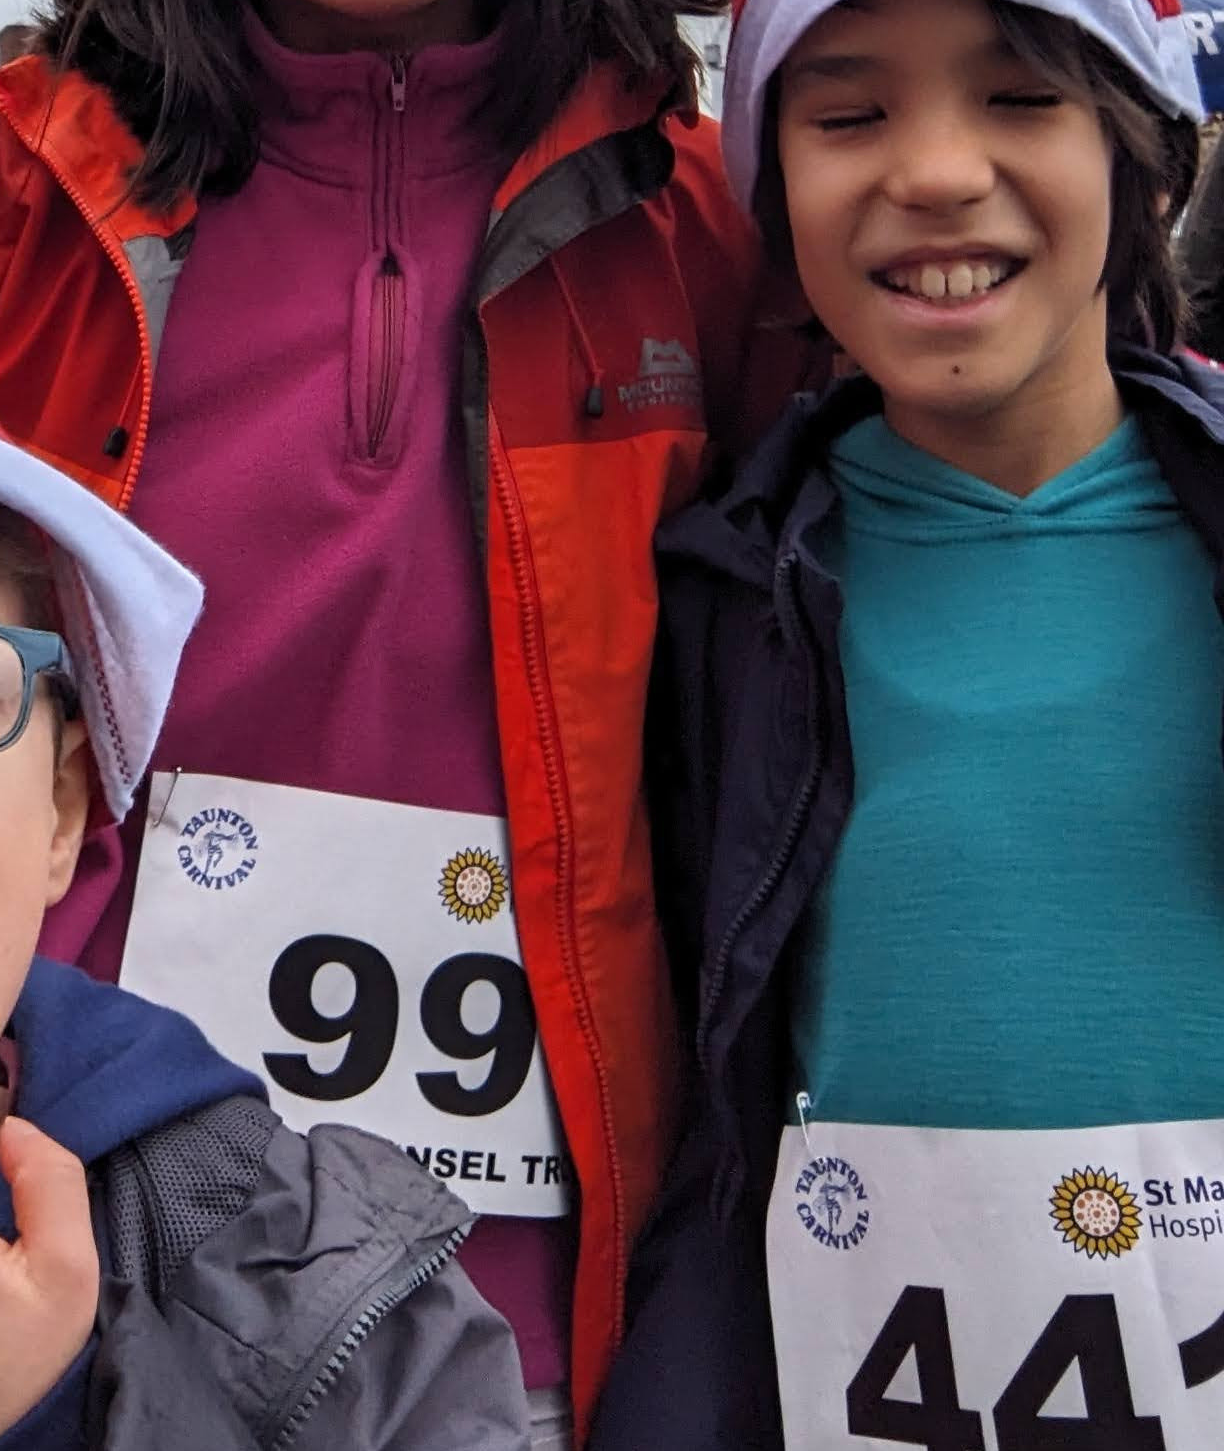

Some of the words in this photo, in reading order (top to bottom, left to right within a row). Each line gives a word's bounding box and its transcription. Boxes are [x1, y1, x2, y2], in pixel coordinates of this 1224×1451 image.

[179, 807, 259, 850] TAUNTON
[177, 844, 257, 890] CARNIVAL
[262, 933, 537, 1117] 99
[795, 1157, 868, 1200] TAUNTON
[1144, 1179, 1177, 1206] St
[1184, 1175, 1224, 1205] Ma
[796, 1203, 870, 1250] CARNIVAL
[1149, 1209, 1223, 1242] Hospi
